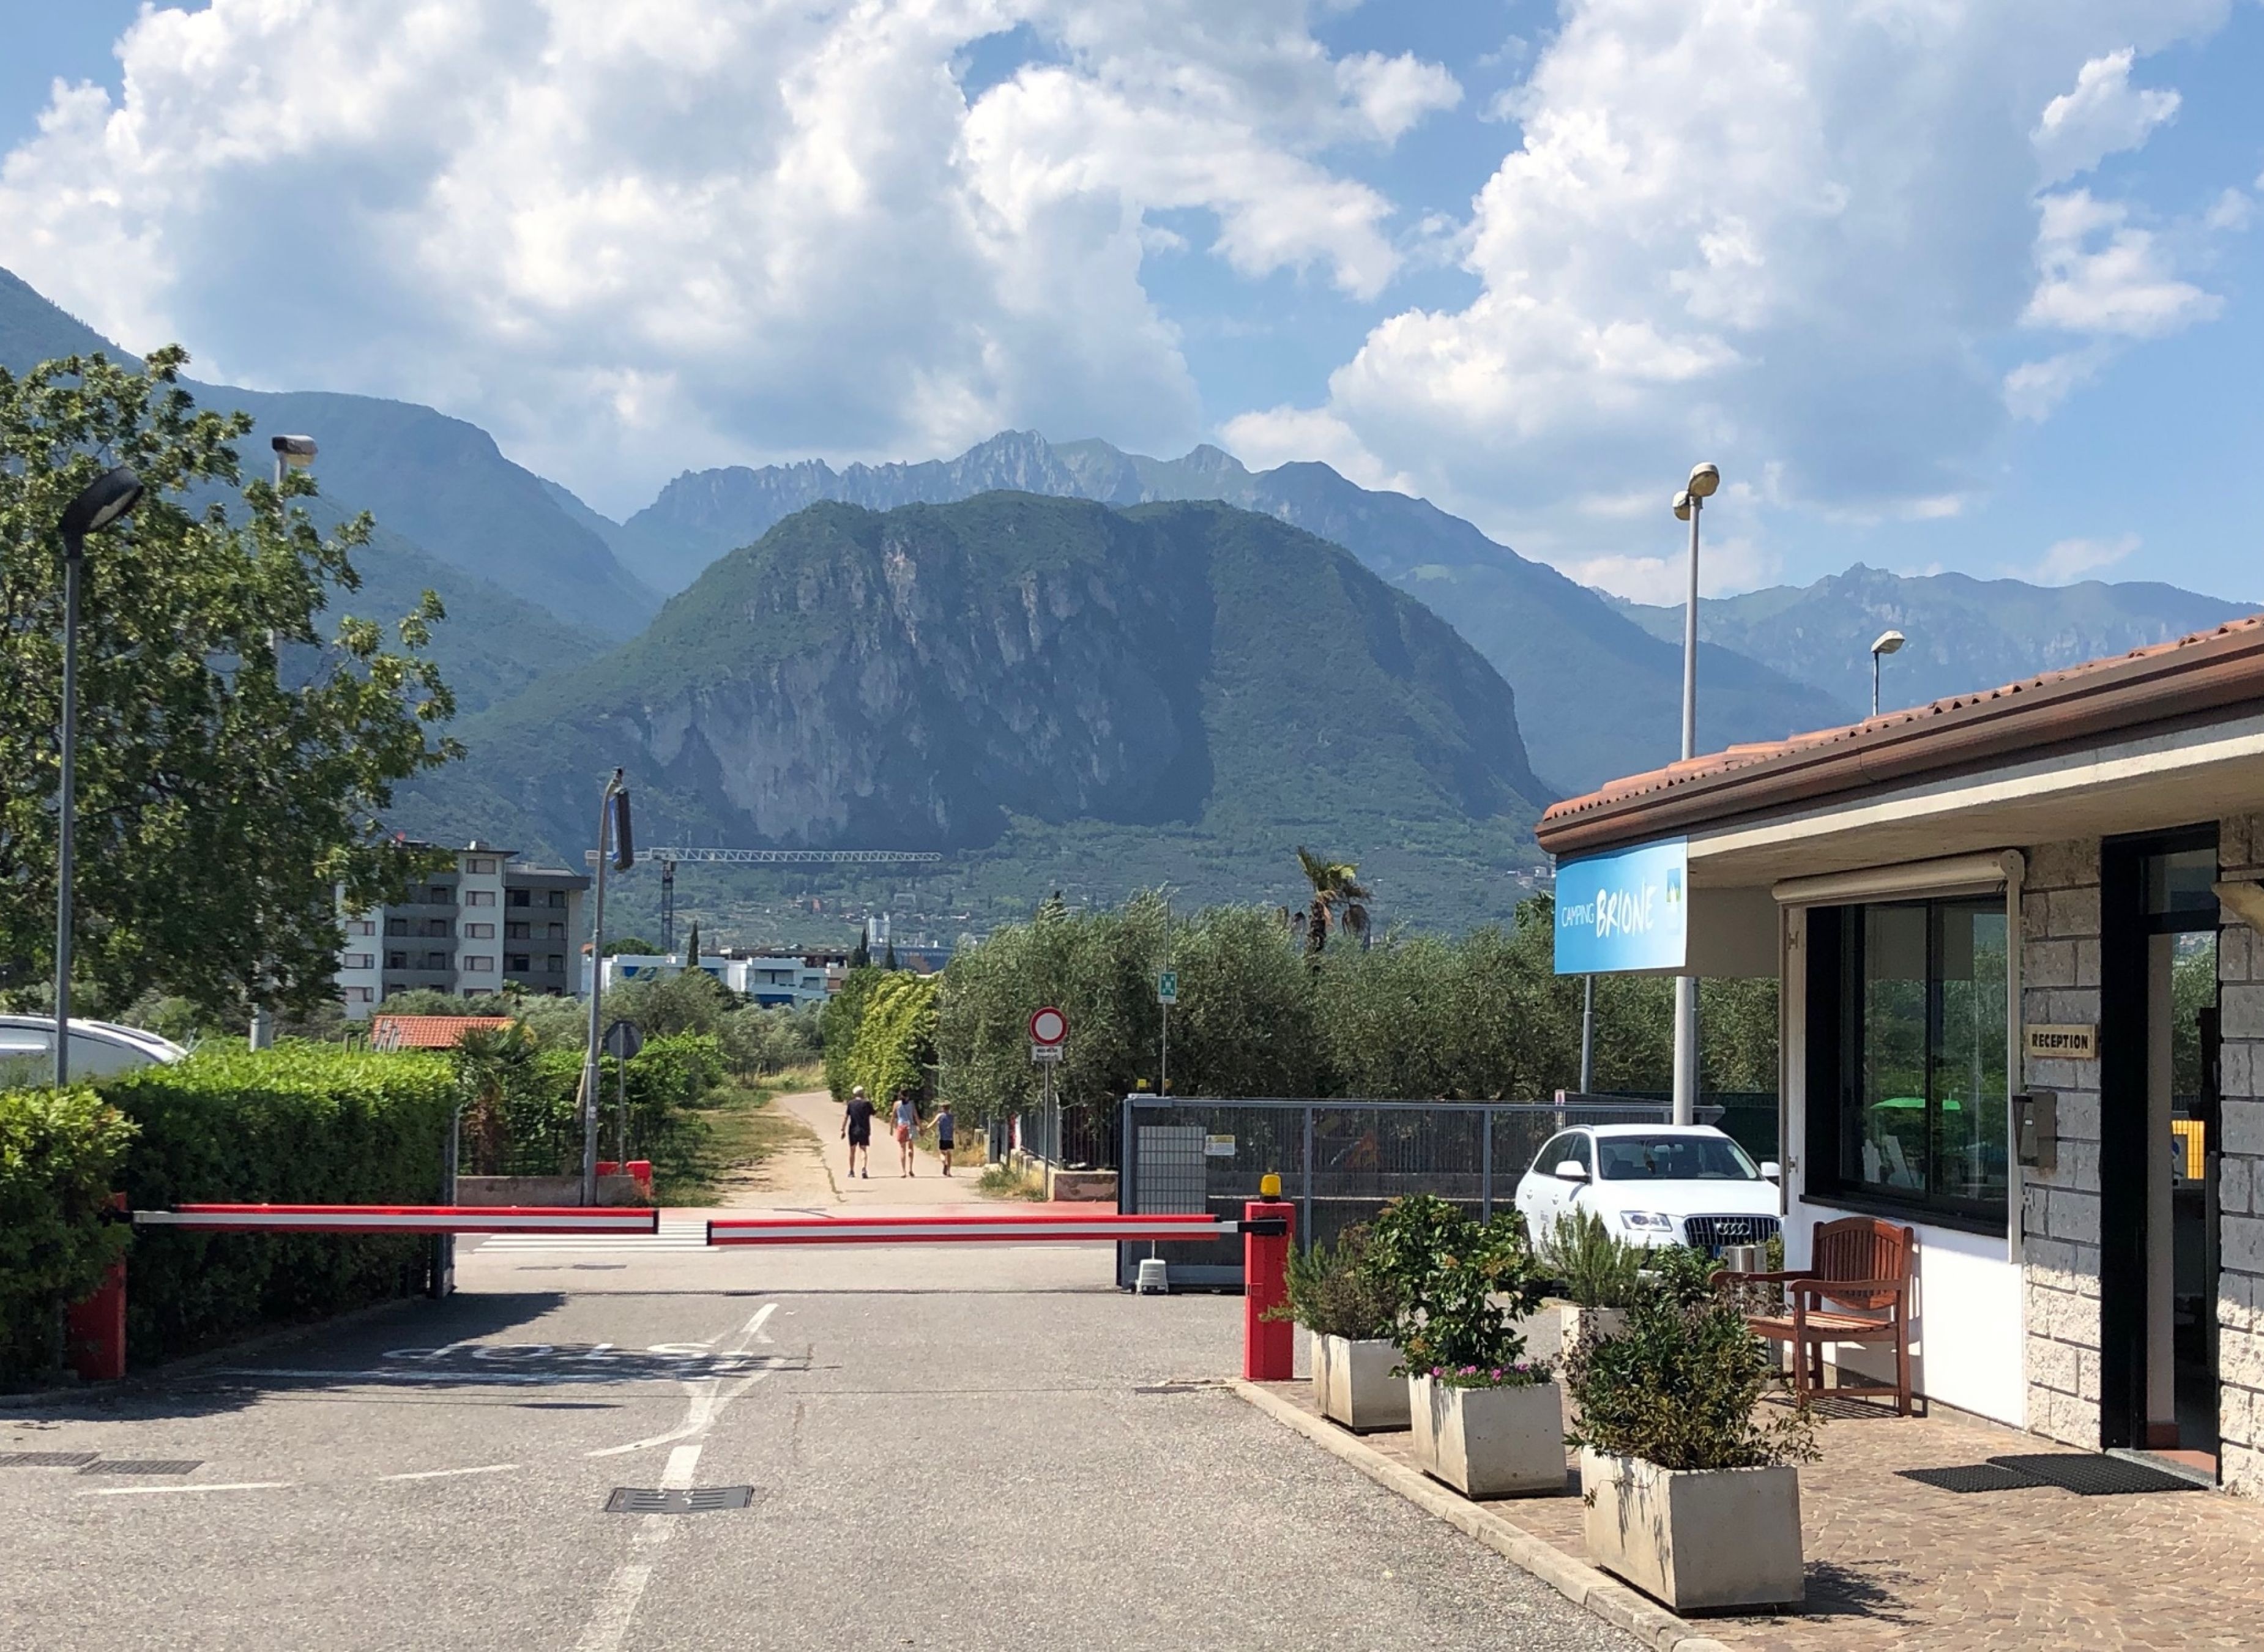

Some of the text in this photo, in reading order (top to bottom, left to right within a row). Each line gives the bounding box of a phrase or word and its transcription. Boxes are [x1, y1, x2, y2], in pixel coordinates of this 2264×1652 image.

[1562, 879, 1658, 938] CAMPING BRIONE
[2031, 1033, 2088, 1049] RECEPTION
[381, 1343, 710, 1360] STOP
